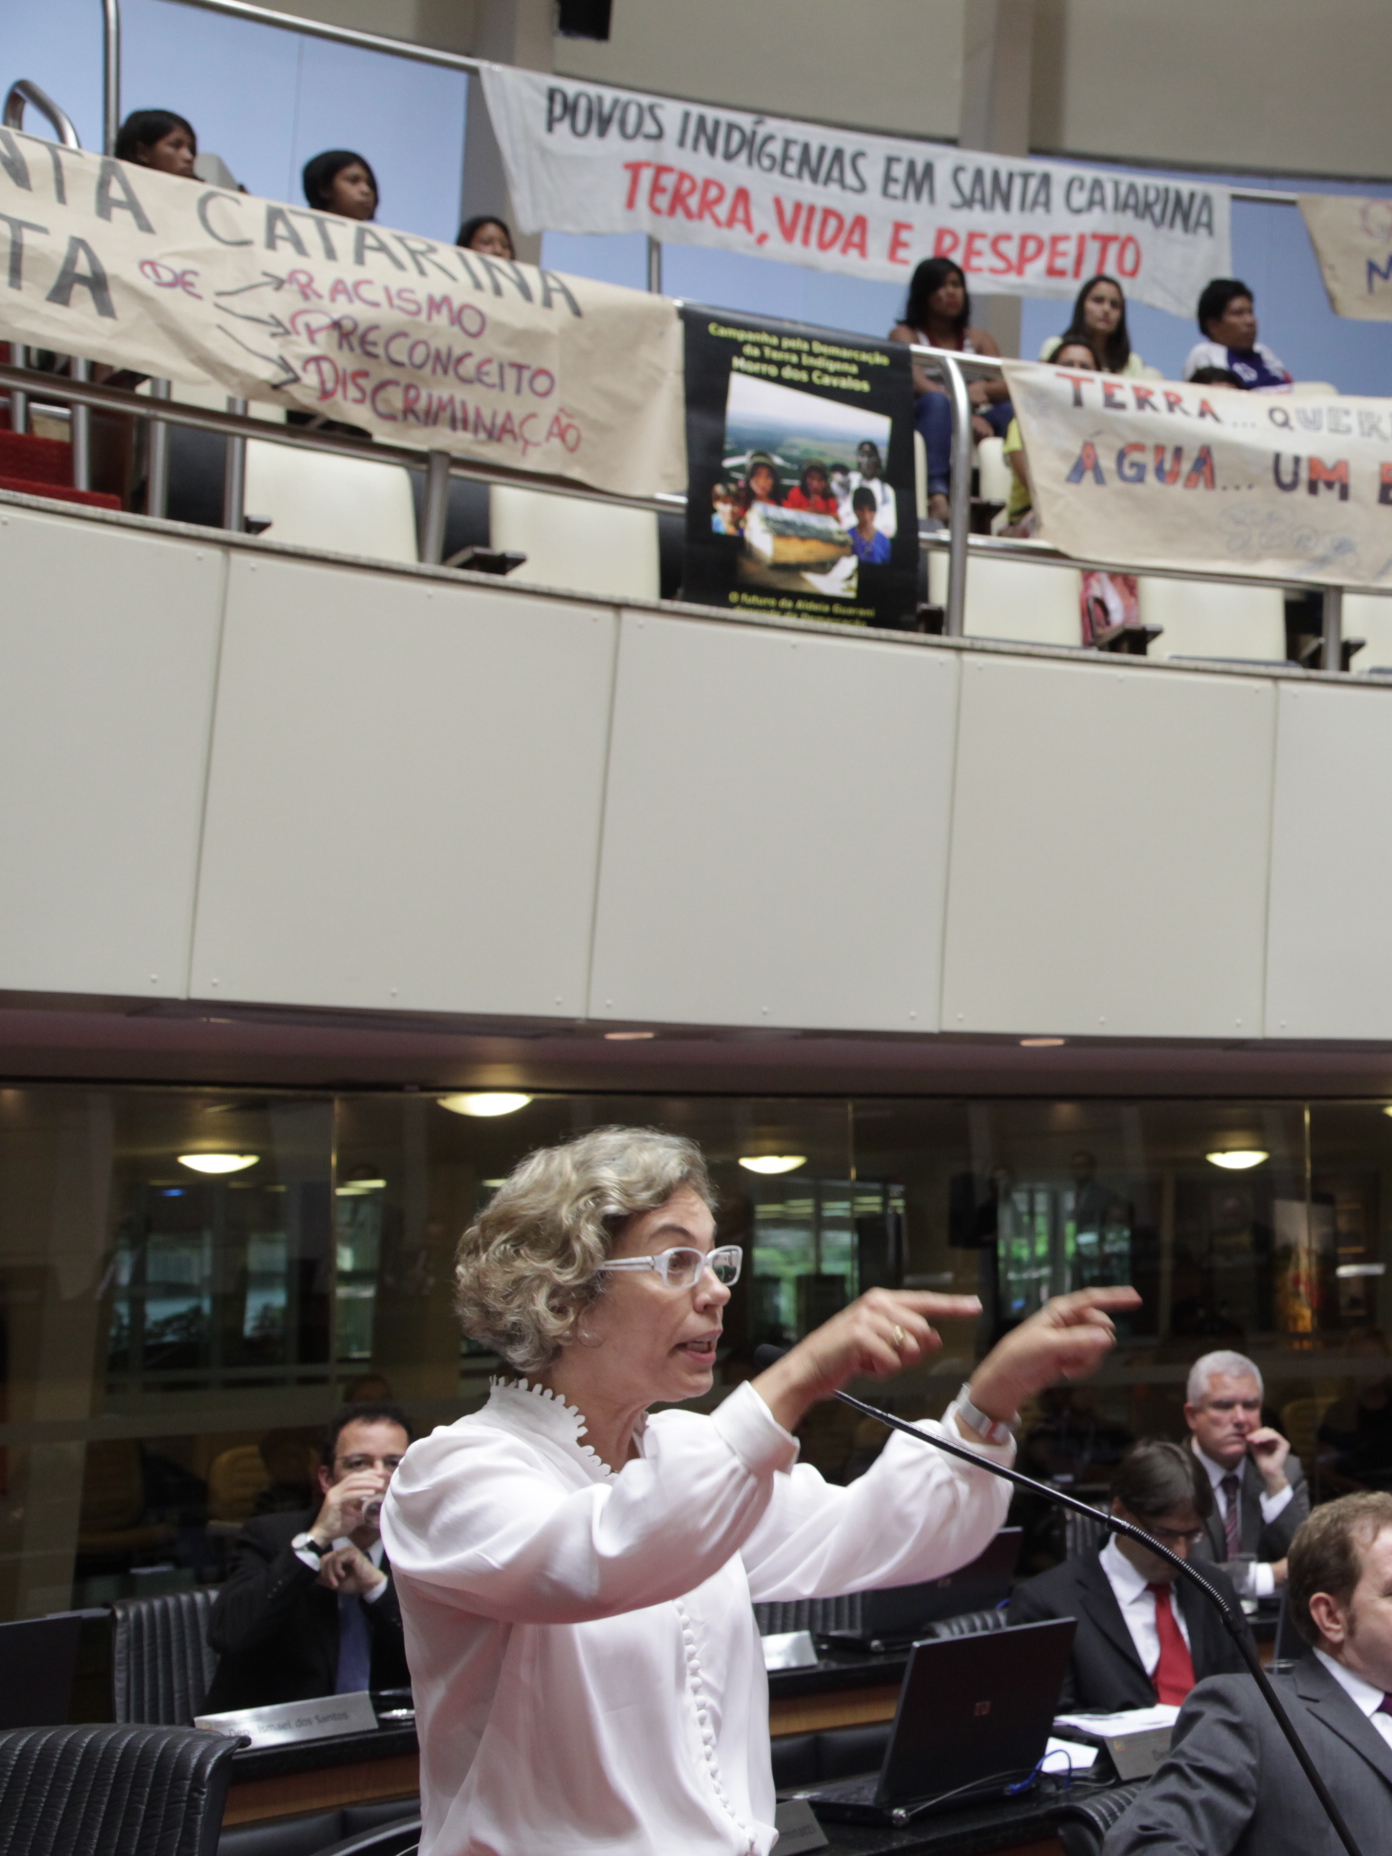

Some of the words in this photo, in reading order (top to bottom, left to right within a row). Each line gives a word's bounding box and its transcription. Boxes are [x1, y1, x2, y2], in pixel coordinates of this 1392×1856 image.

[546, 87, 664, 141] POVOS
[677, 116, 867, 194] INDÍGENAS
[882, 155, 935, 205] EM
[950, 165, 1053, 214] SANTA
[1065, 175, 1216, 237] CATARINA
[197, 190, 582, 318] CATARINA
[888, 221, 915, 265] E
[932, 227, 1142, 279] RESPEITO
[138, 260, 204, 301] DE
[287, 269, 487, 339] RACISMO
[290, 309, 555, 398] PRECONCEITO
[708, 322, 779, 346] Campanha
[781, 337, 810, 352] pela
[812, 340, 890, 367] Demarcação
[762, 346, 799, 364] Terra
[732, 355, 779, 377] Morro
[781, 365, 809, 383] dos
[811, 370, 871, 393] Cavalos
[303, 356, 582, 456] DISCRIMINAÇÃO
[1273, 452, 1349, 502] UM
